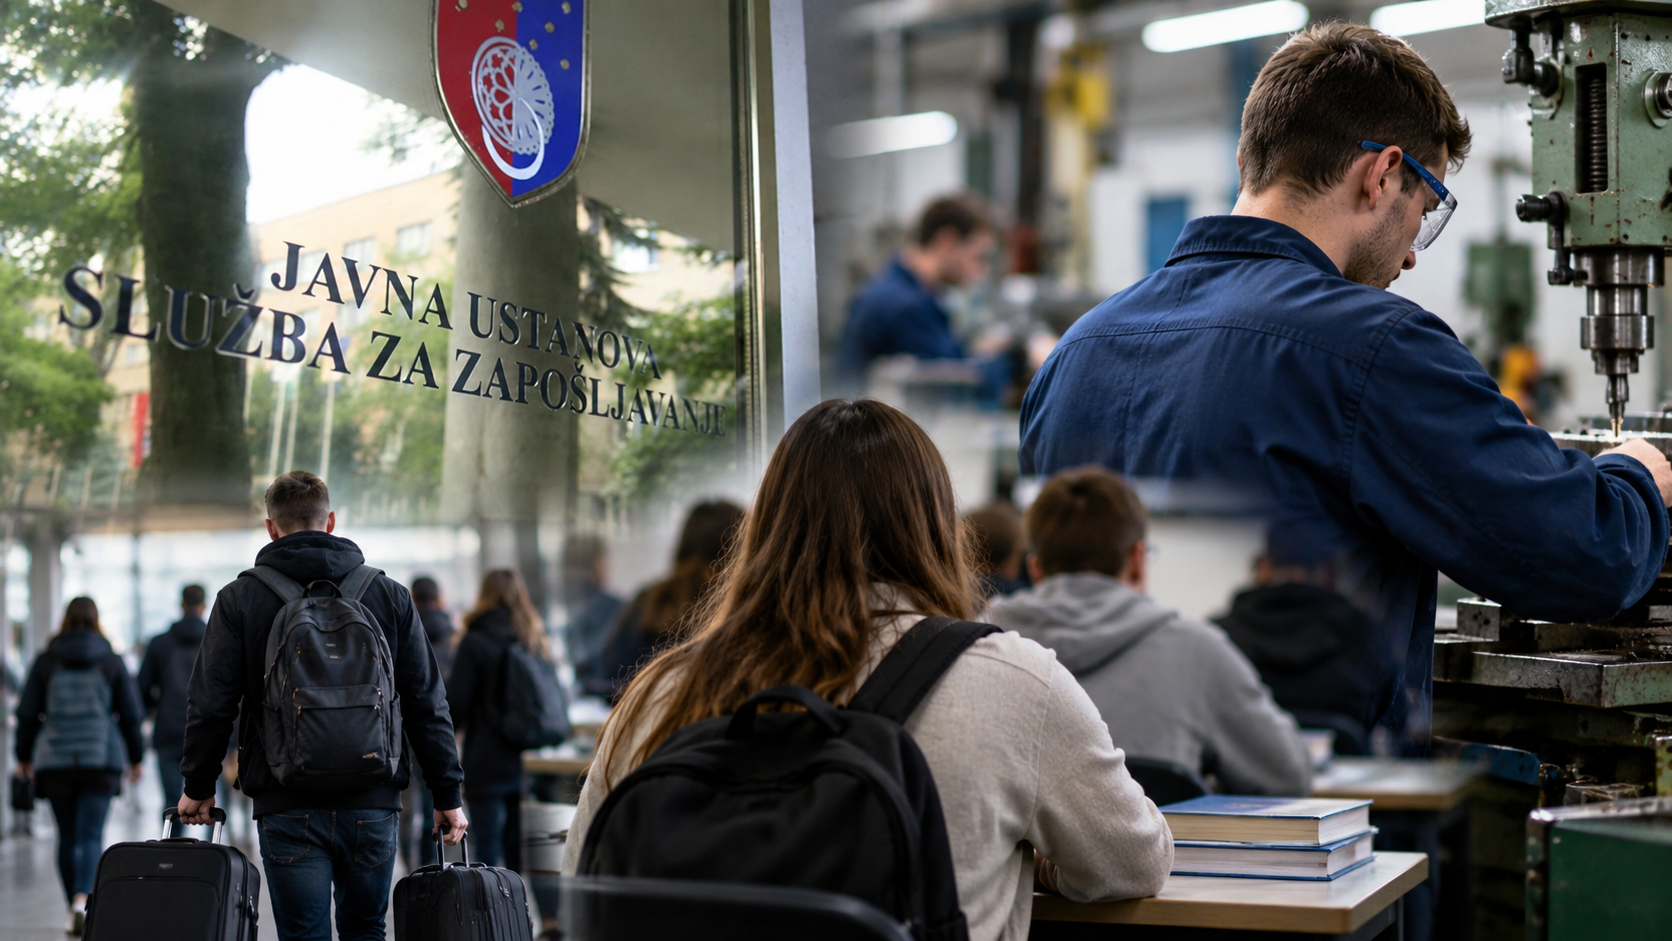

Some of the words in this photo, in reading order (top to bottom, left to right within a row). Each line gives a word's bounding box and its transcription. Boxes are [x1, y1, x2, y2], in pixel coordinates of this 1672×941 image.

[58, 266, 351, 374] SLUŽBA
[366, 330, 439, 389] ZA
[451, 348, 726, 437] ZAPOŠLJAVANJE
[270, 241, 453, 330] JAVNA
[467, 291, 661, 380] USTANOVA
